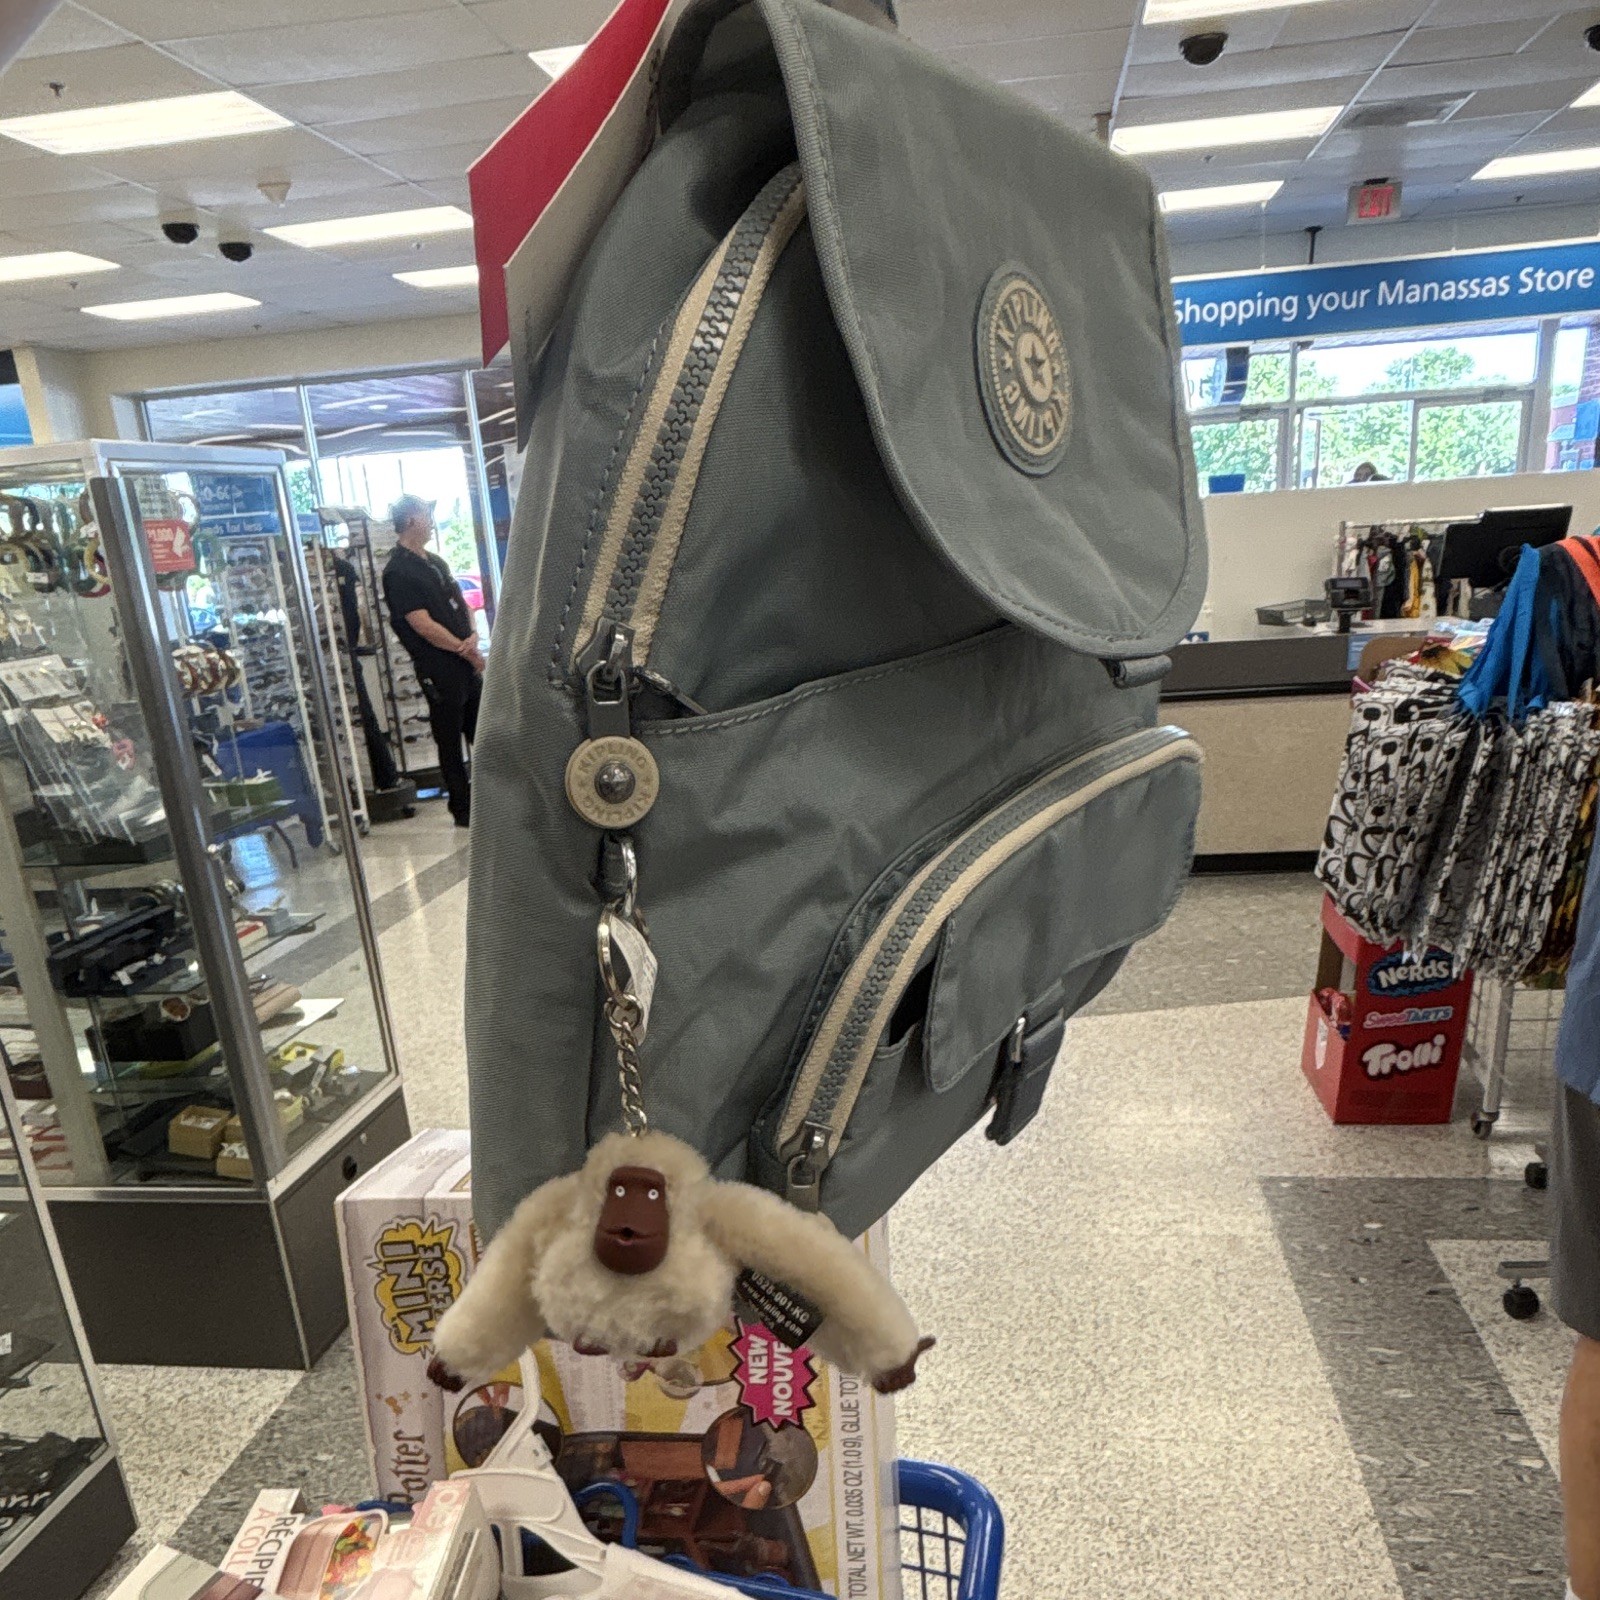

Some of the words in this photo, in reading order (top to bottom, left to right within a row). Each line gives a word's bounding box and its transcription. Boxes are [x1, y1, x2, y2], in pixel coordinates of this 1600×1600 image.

[1358, 186, 1393, 218] EXIT
[1173, 290, 1299, 328] Shopping
[1306, 288, 1372, 320] your
[1377, 275, 1511, 306] Manassas
[1518, 266, 1595, 295] Store
[997, 290, 1061, 354] KIPLING
[1362, 1034, 1446, 1077] Trolli
[380, 1240, 434, 1344] MINI
[418, 1242, 453, 1320] ERSE
[748, 1333, 769, 1384] NEW
[841, 1399, 860, 1433] GLUE
[843, 1470, 863, 1487] OZ
[253, 1508, 278, 1521] A
[845, 1488, 864, 1517] 0.035
[846, 1518, 865, 1539] WT.
[225, 1525, 267, 1571] COLL
[846, 1540, 866, 1562] NET
[848, 1563, 867, 1599] TOTAL
